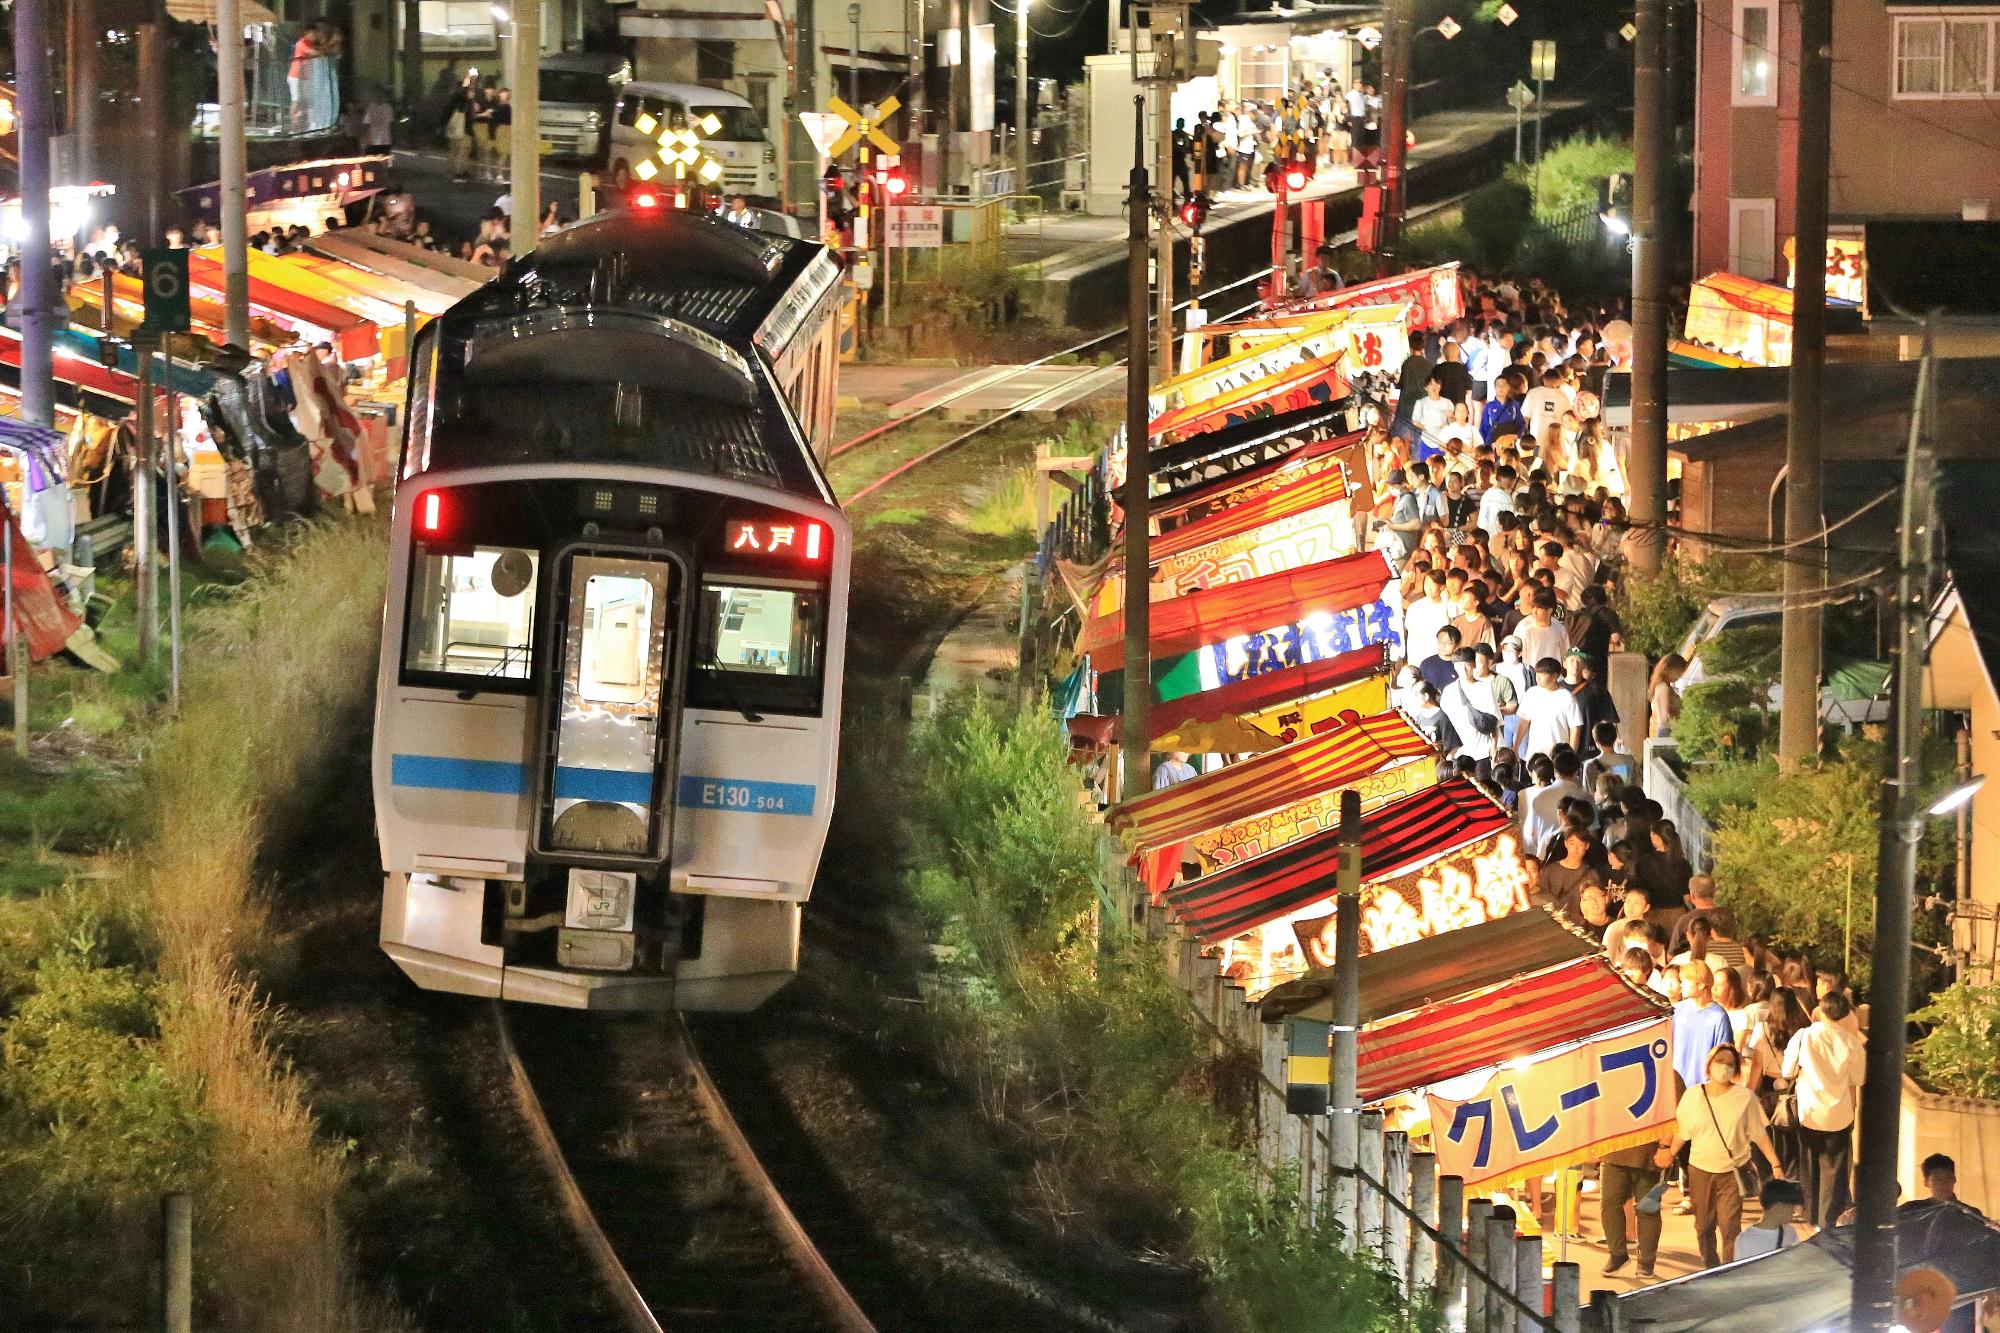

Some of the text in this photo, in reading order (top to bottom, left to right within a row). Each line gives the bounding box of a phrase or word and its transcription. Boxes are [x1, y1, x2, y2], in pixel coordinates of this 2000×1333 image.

[151, 261, 180, 298] 6
[734, 525, 796, 553] 八戸
[1175, 546, 1220, 568] サクサク
[594, 901, 610, 911] JR
[1447, 1038, 1668, 1168] クレープ
